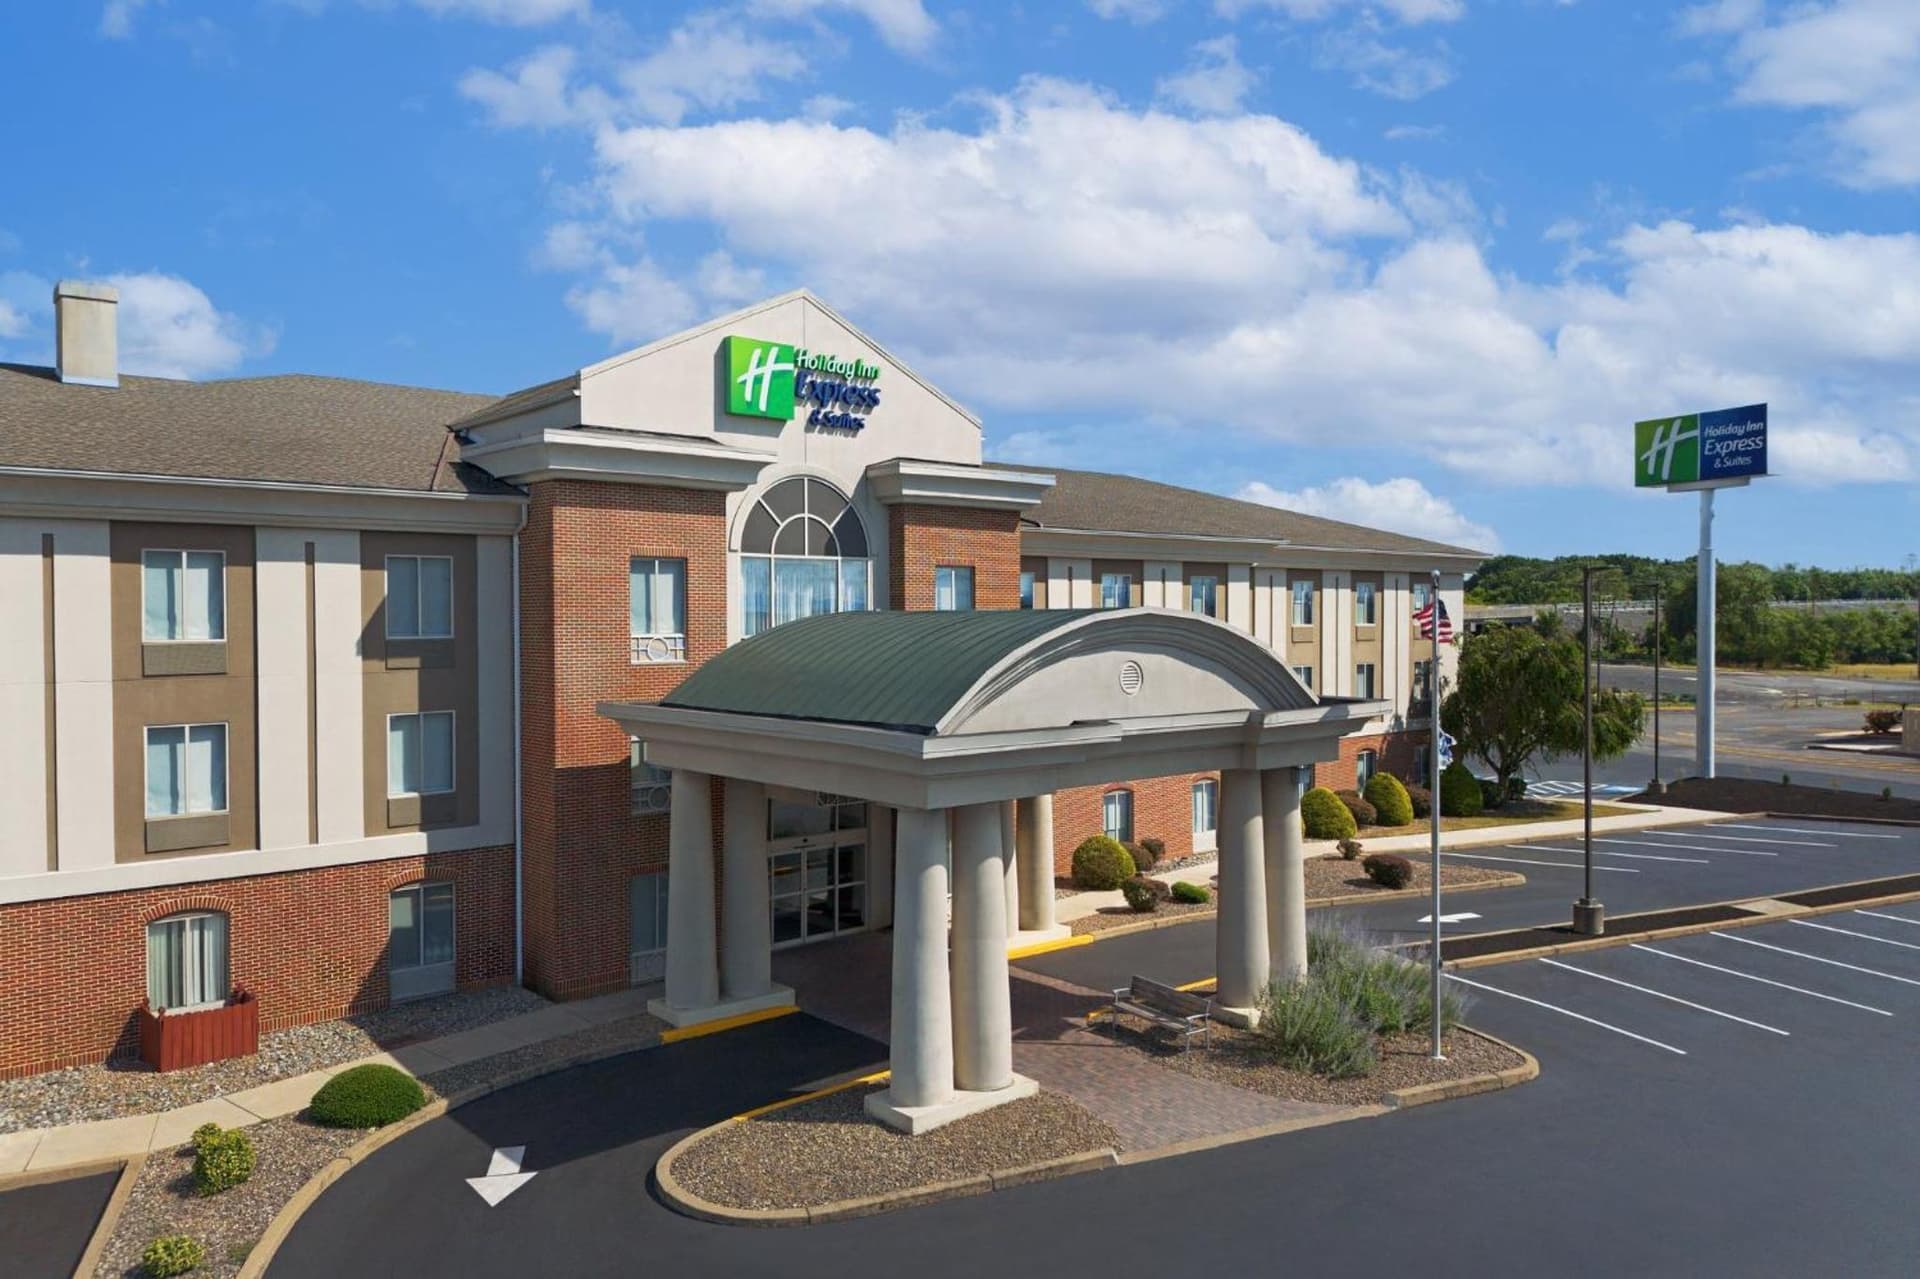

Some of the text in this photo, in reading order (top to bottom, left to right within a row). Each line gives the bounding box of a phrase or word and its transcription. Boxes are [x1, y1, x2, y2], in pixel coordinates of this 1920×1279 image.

[797, 349, 880, 379] Holiday Inn
[796, 370, 881, 407] Express
[1704, 420, 1763, 436] Holiday Inn
[1704, 436, 1763, 456] Express
[1713, 457, 1752, 469] & Suites
